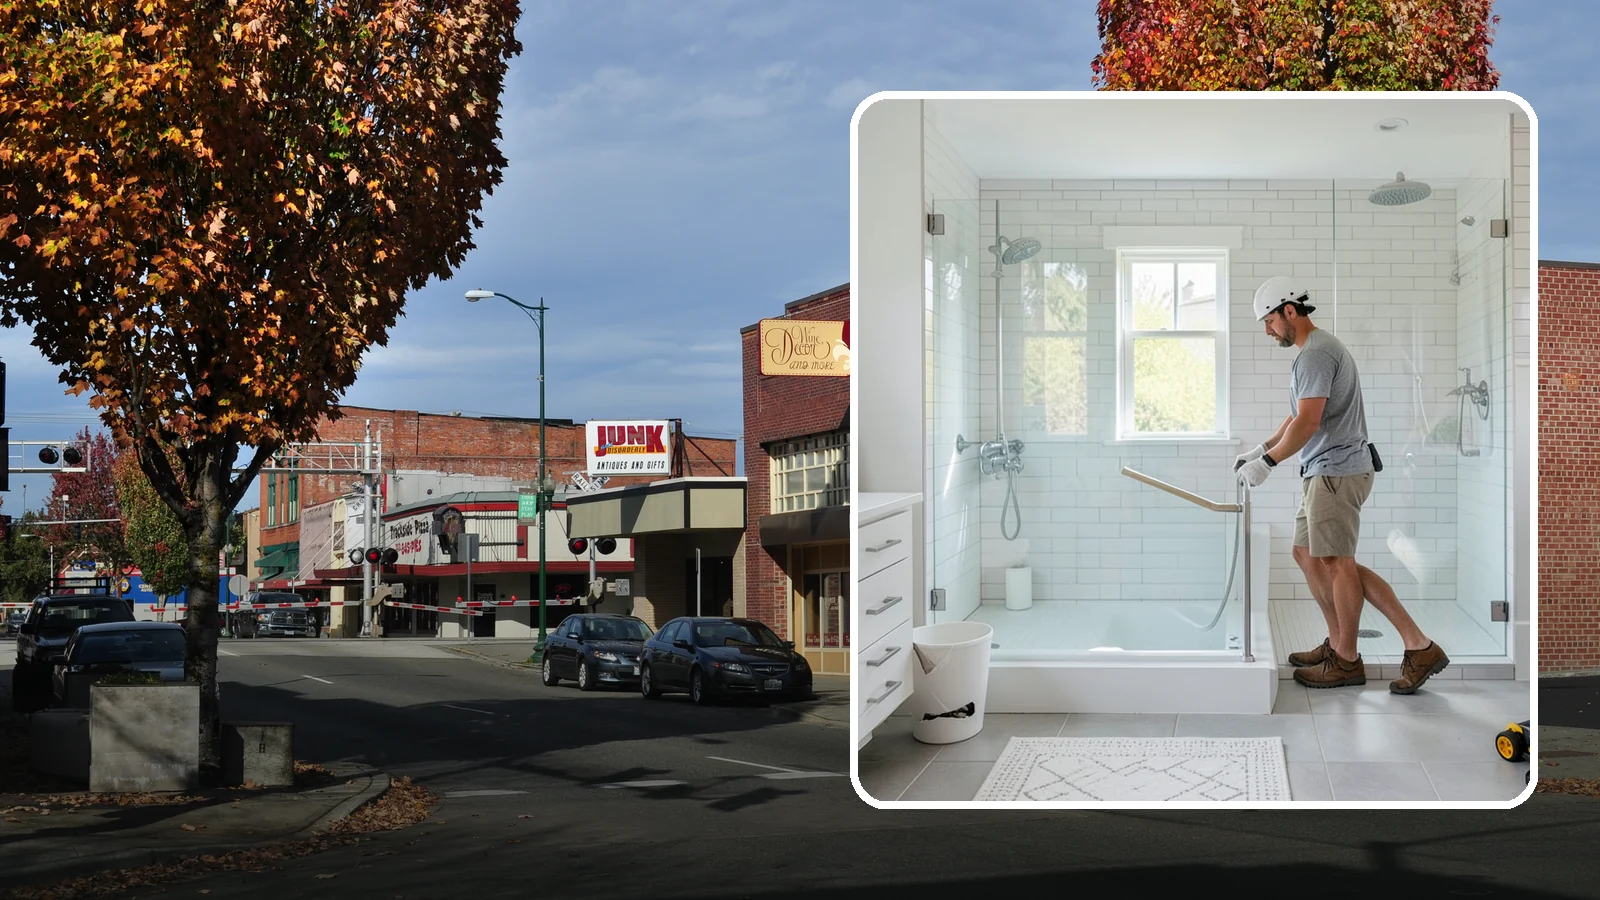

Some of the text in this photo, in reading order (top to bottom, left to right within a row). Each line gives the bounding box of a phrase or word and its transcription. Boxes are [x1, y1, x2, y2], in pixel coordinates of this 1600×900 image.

[595, 425, 665, 457] JUNK
[607, 446, 646, 454] DISORDERLY
[596, 460, 665, 470] ANTIQUES AND GIFTS
[590, 476, 608, 491] SING
[414, 519, 429, 535] Pizza
